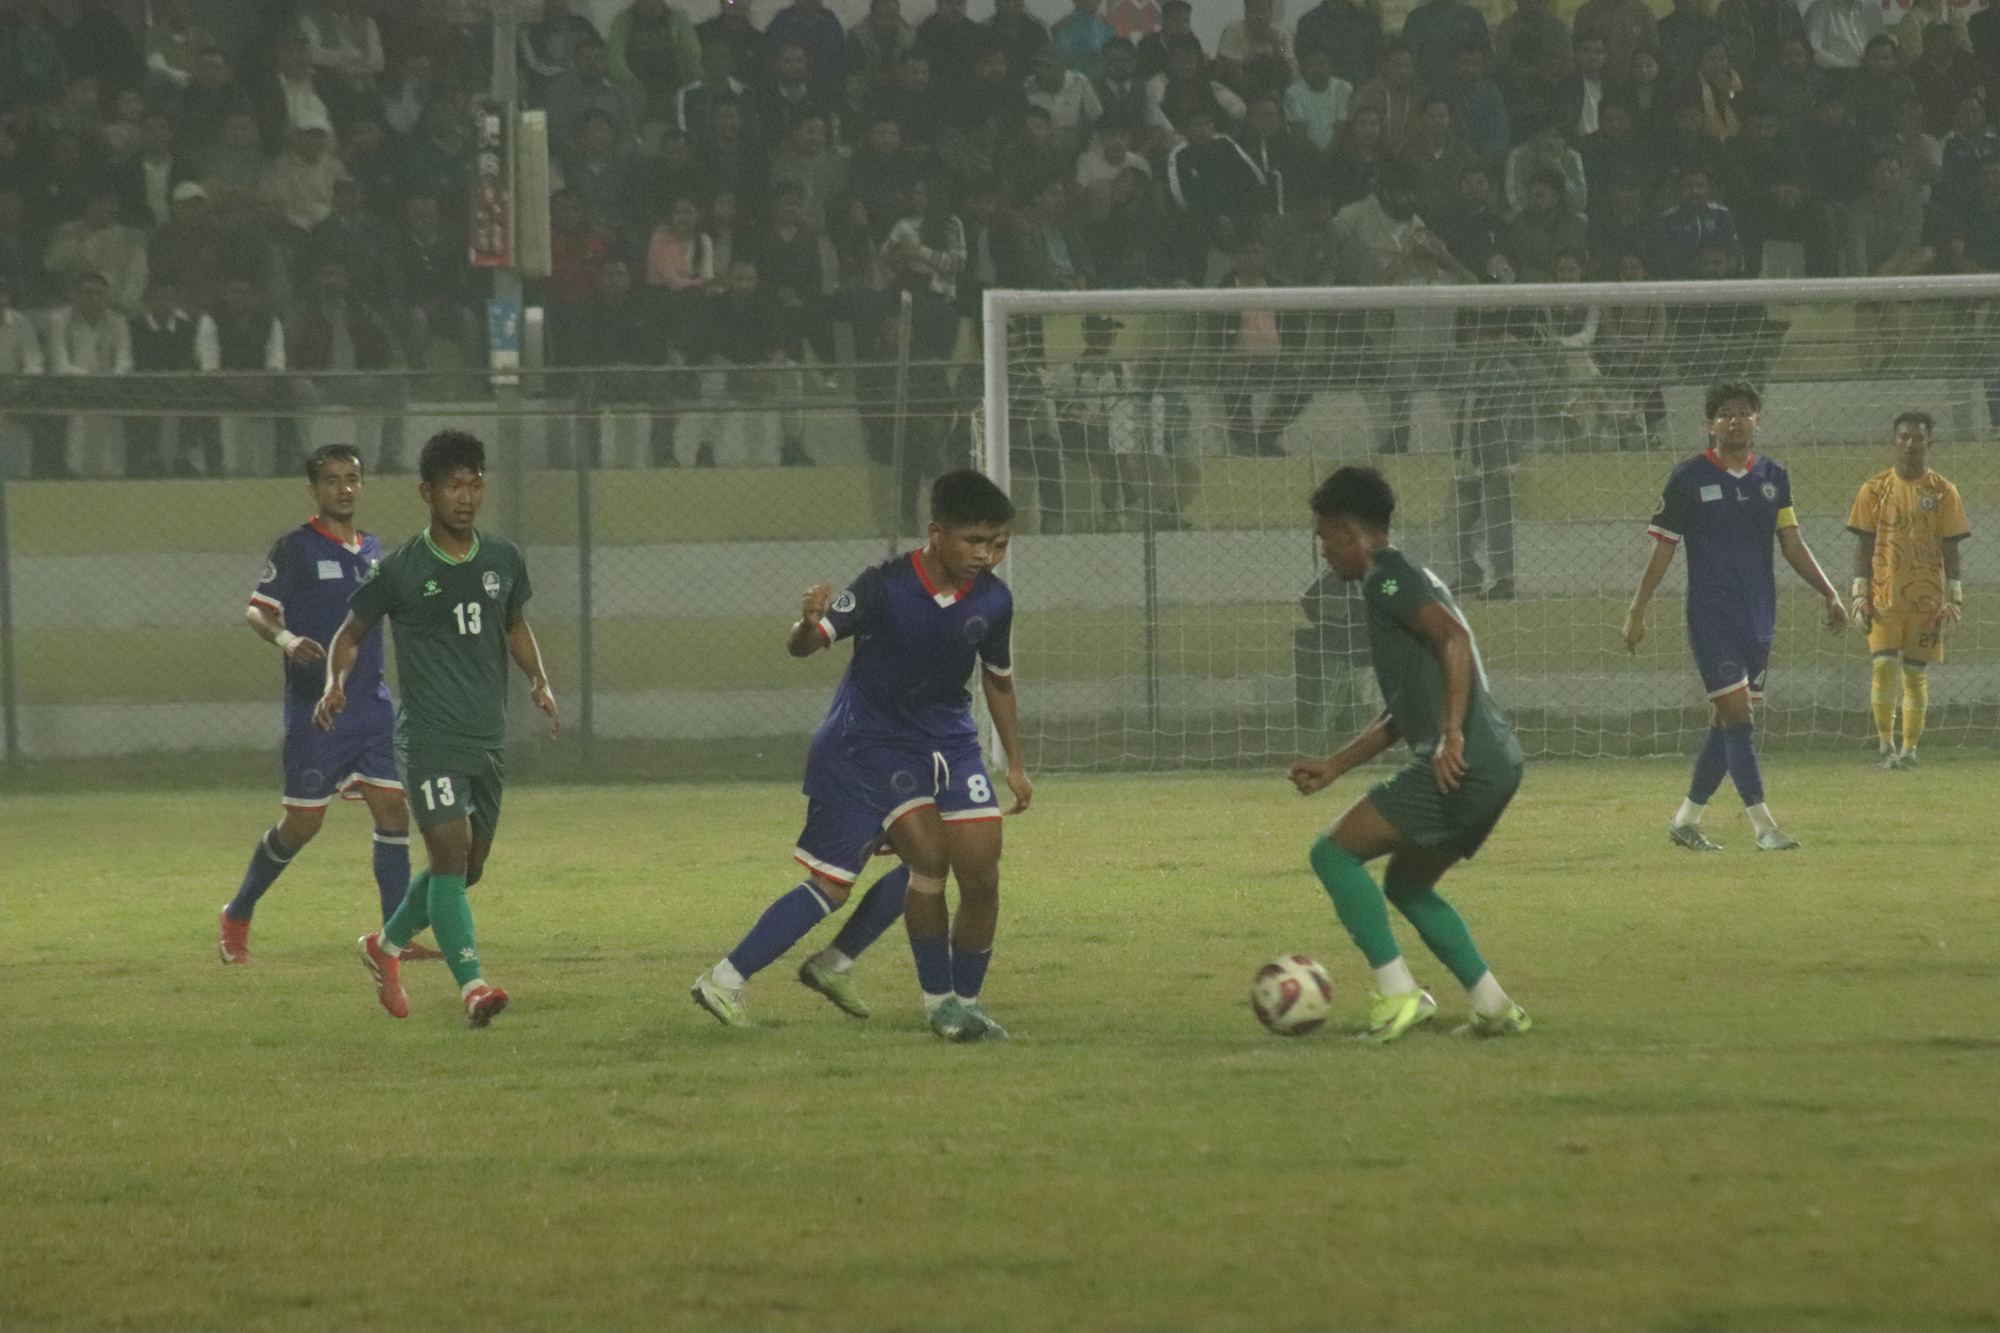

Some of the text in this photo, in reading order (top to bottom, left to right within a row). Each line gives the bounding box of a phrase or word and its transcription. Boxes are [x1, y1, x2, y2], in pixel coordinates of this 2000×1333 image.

[453, 602, 482, 635] 13
[1918, 632, 1940, 649] 27
[420, 776, 456, 811] 13
[967, 774, 991, 803] 8
